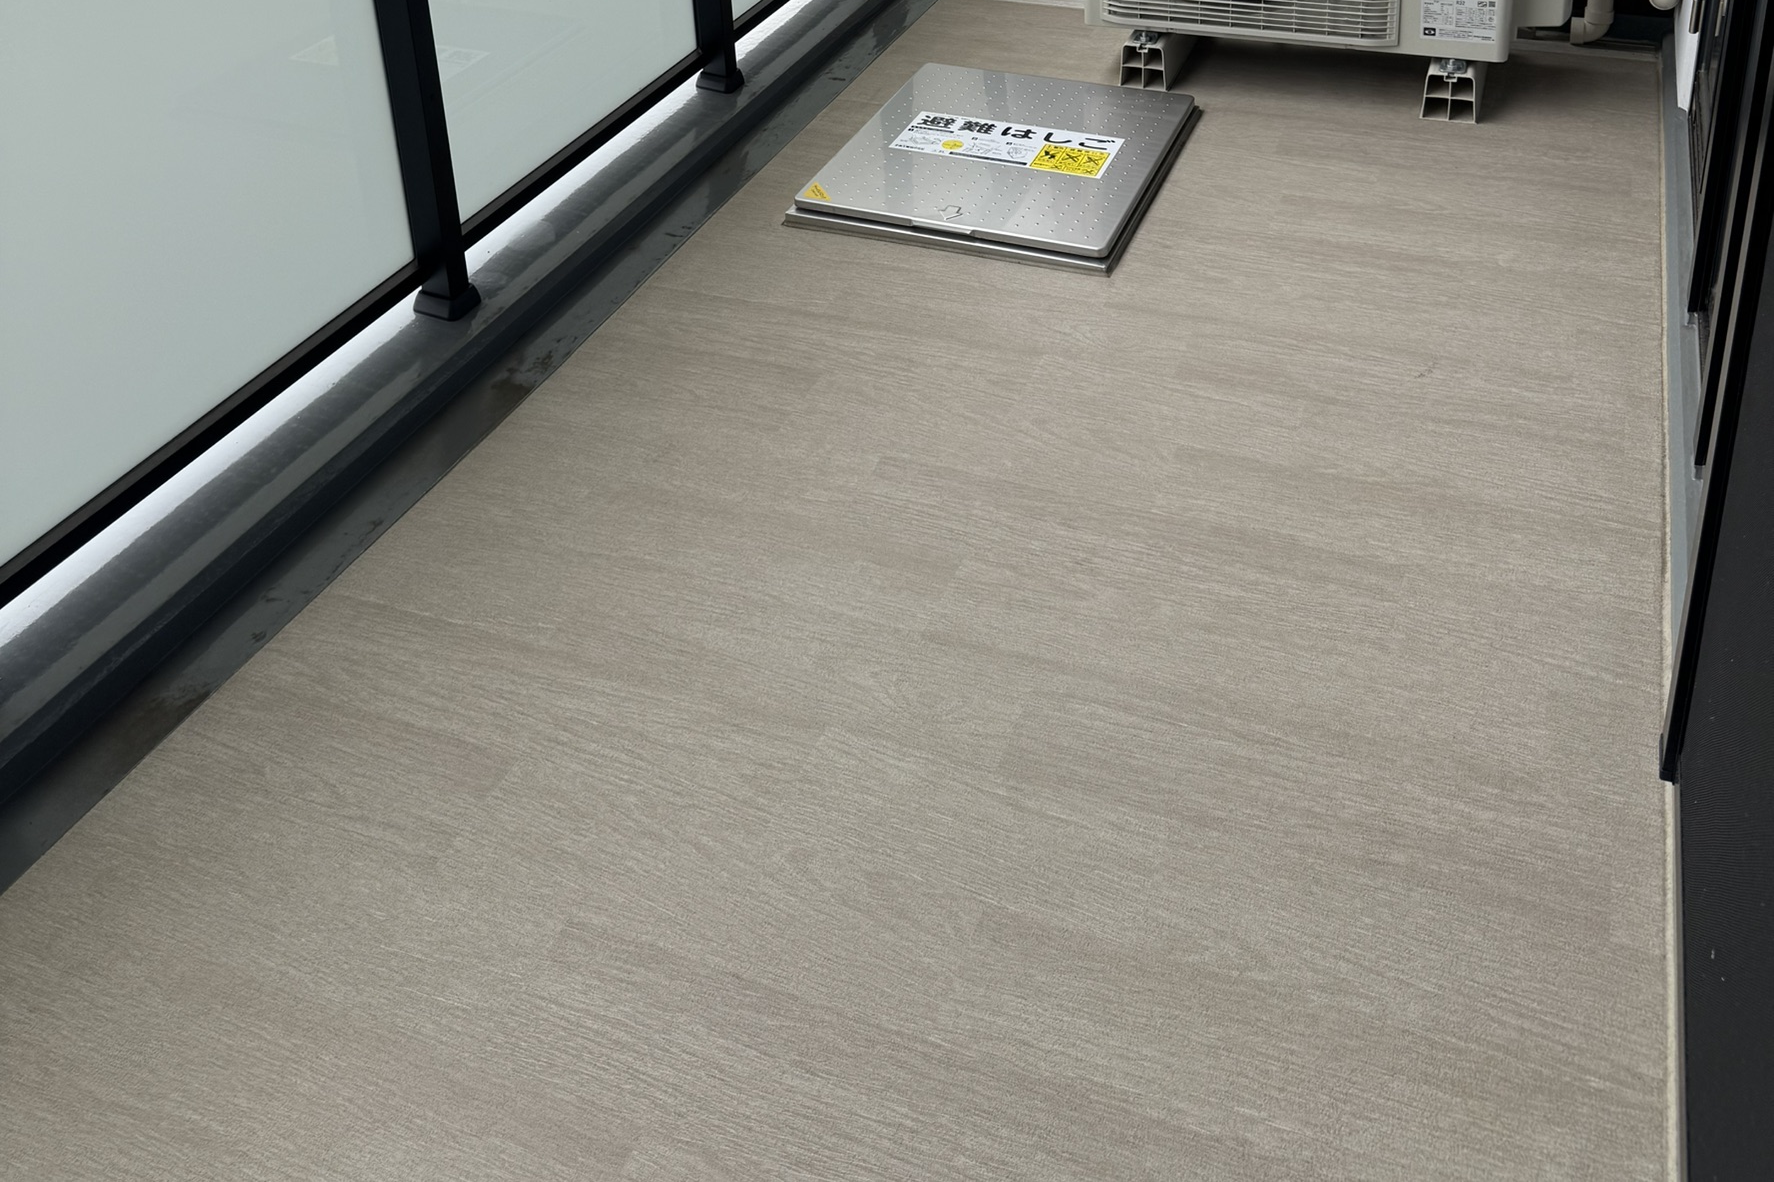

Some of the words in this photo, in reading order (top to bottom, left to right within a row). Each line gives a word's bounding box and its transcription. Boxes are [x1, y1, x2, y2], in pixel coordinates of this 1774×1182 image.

[917, 115, 1116, 150] 避難はしご
